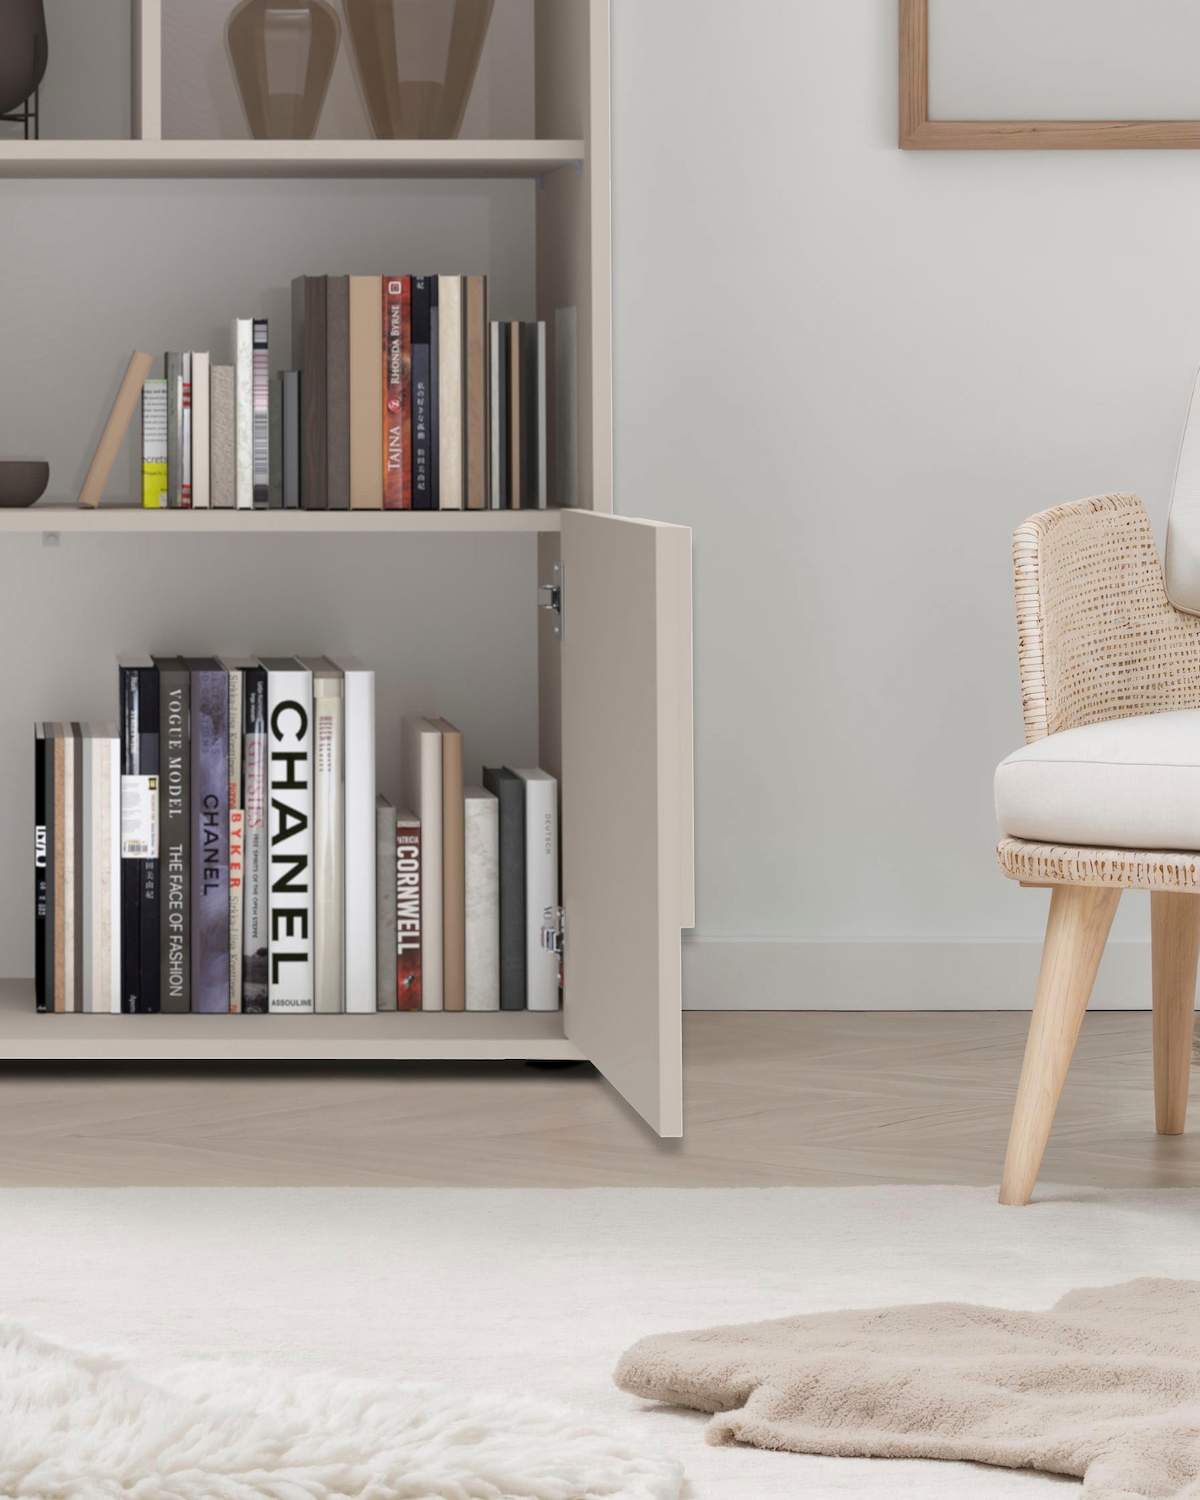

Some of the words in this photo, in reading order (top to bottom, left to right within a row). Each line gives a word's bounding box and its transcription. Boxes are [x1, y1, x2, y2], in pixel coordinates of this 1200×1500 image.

[390, 304, 400, 336] BYRNE
[390, 340, 400, 384] RHONDA
[388, 426, 402, 472] TAJNA
[169, 689, 182, 749] VOGUE
[169, 757, 182, 819] MODEL
[248, 741, 265, 828] GYPSIES
[169, 844, 183, 872] THE
[204, 794, 219, 896] CHANEL
[230, 813, 241, 888] BYKER
[271, 700, 308, 984] CHANEL
[169, 872, 183, 909] FACE
[397, 846, 420, 955] CORNWELL
[169, 913, 183, 933] OF
[169, 935, 183, 997] FASHION
